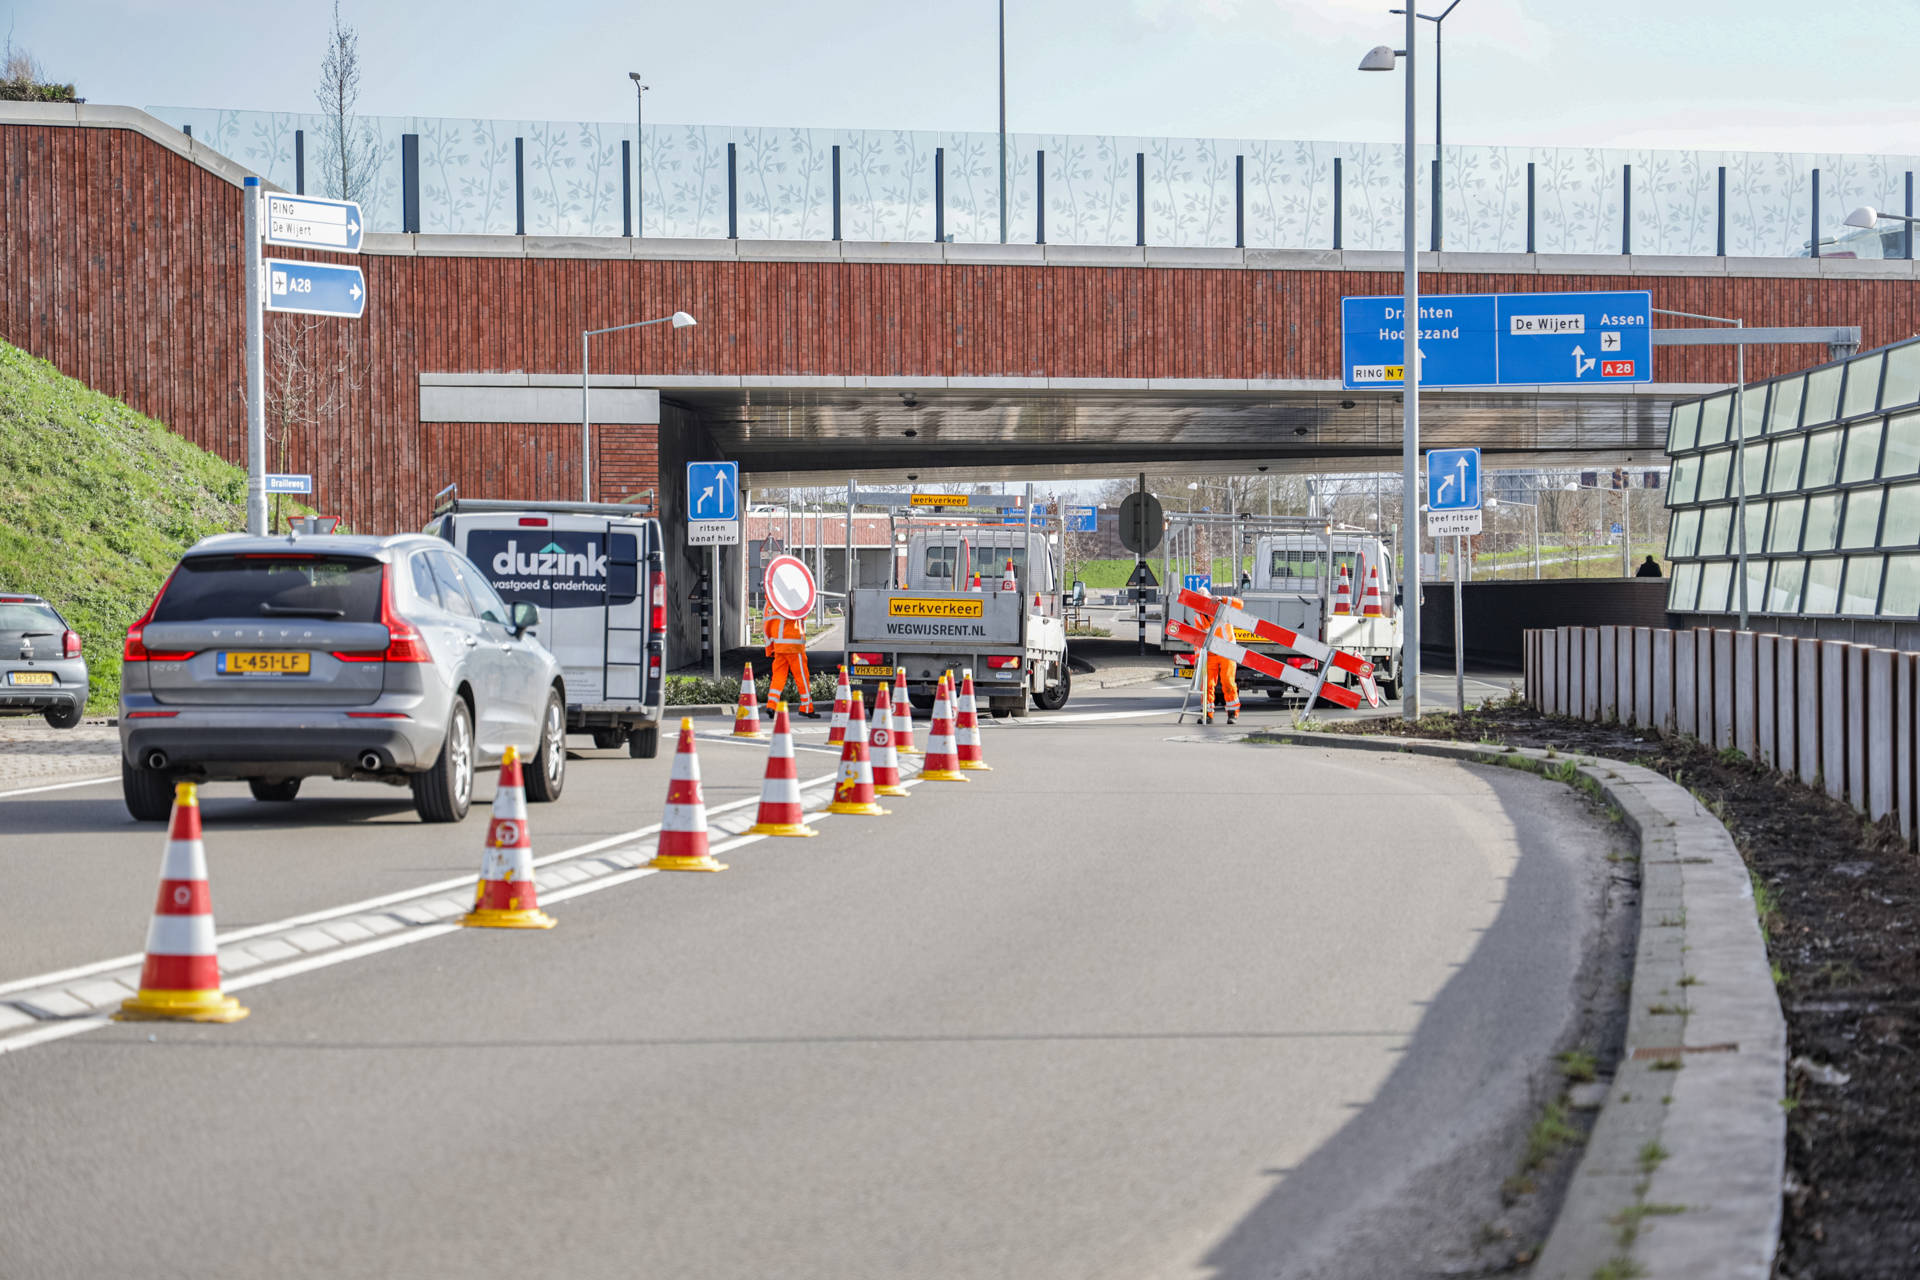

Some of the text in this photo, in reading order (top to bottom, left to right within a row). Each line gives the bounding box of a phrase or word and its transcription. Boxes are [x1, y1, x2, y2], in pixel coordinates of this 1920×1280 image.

[272, 202, 294, 215] RING
[273, 221, 312, 237] De Wijert
[289, 277, 312, 293] A28
[1385, 307, 1453, 320] Drhten
[1600, 313, 1644, 326] Assen
[1516, 318, 1580, 332] De Wijert
[1379, 327, 1460, 340] Hooezand
[1355, 369, 1383, 378] RING
[271, 478, 304, 490] Brailleweg
[1429, 514, 1449, 523] geef
[493, 540, 607, 577] duzink
[492, 579, 540, 592] vastgoed
[542, 580, 550, 590] &
[893, 602, 979, 614] werkverkeer
[887, 623, 986, 636] WEGWIJSRENT.NL
[234, 656, 299, 669] L-451-LF
